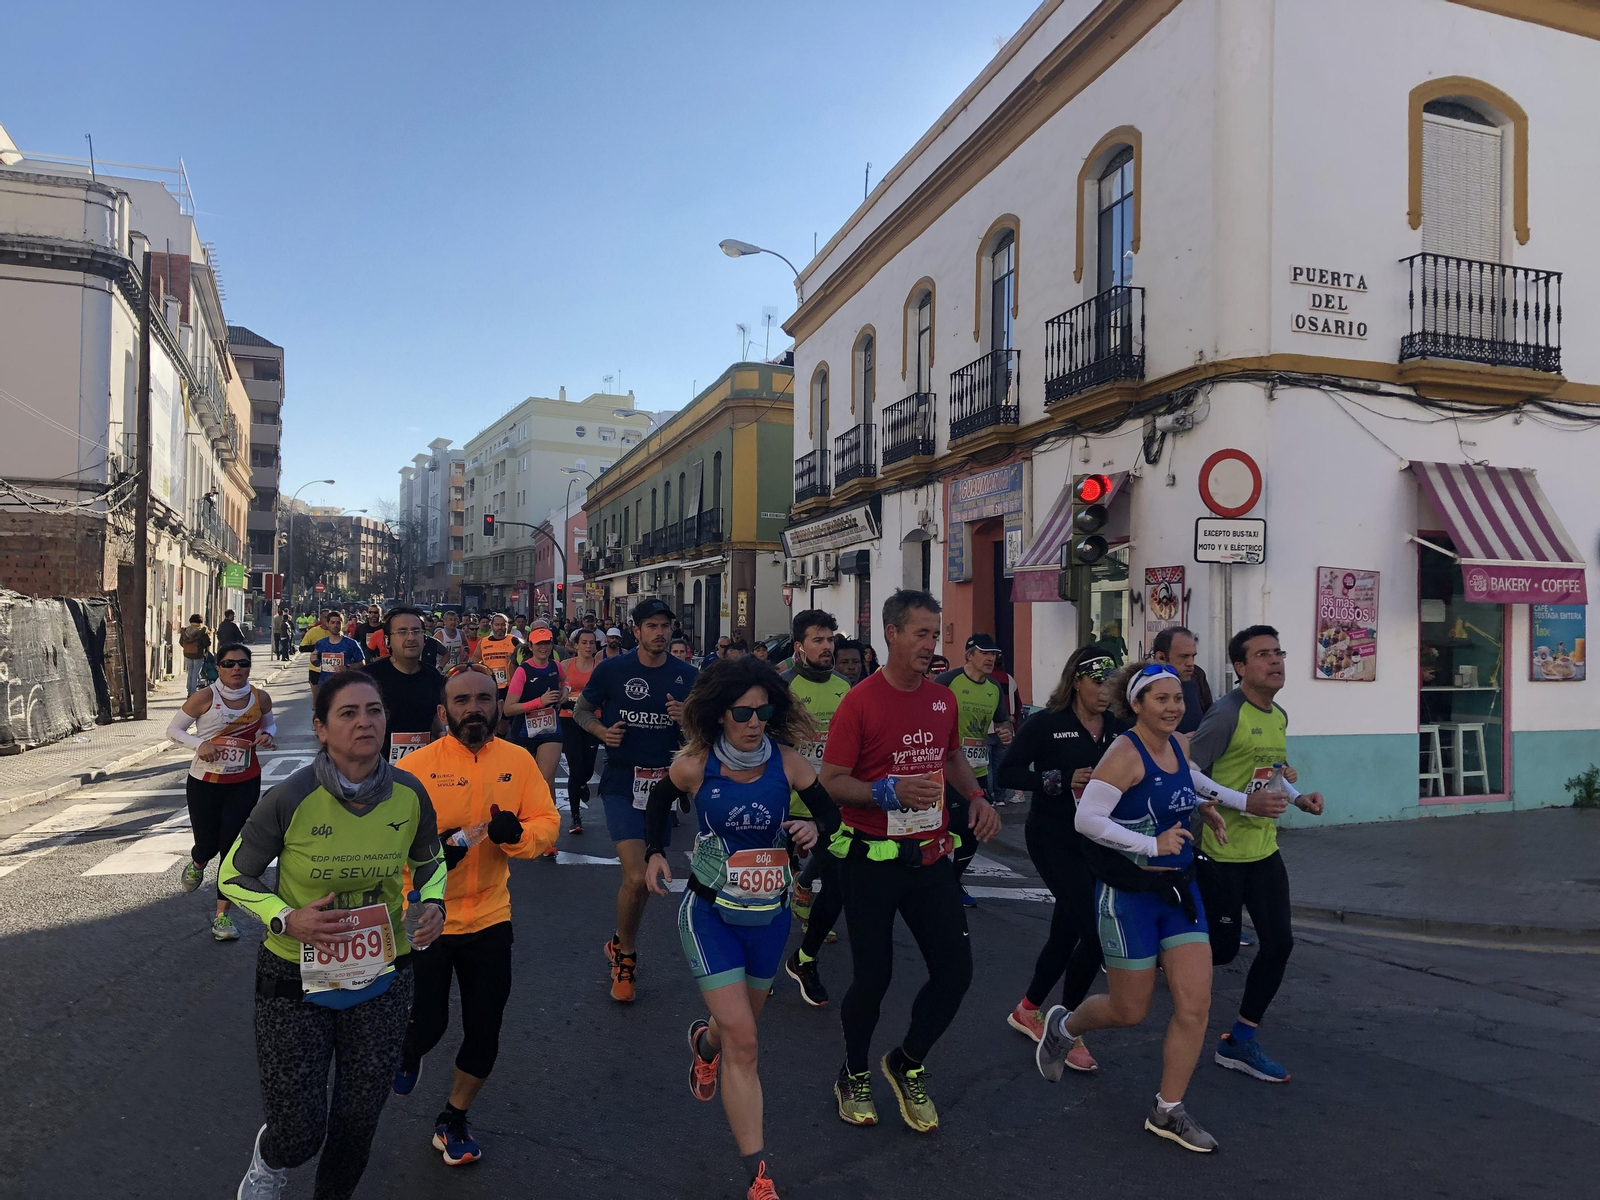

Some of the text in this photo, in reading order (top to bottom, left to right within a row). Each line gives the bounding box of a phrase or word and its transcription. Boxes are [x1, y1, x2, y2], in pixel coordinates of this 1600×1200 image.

[1292, 266, 1368, 290] PUERTA
[1311, 293, 1348, 311] DEL
[1295, 314, 1368, 337] OSARIO
[1203, 529, 1259, 538] EXCEPTO BUS-TAXI
[1198, 543, 1216, 551] MOTO
[1217, 543, 1222, 551] Y
[1230, 542, 1263, 552] ELÉCTRICO
[1490, 577, 1581, 593] BAKERY COFFEE
[1321, 594, 1334, 607] los
[1320, 606, 1369, 622] GOLOSOS
[932, 699, 947, 713] edp
[531, 715, 552, 729] 8750
[619, 709, 674, 726] TORRES
[902, 728, 934, 746] edp
[1052, 731, 1079, 739] KAWTAR
[217, 748, 245, 763] 637
[904, 746, 939, 757] maratón
[912, 752, 940, 763] sevilla
[311, 823, 333, 839] edp
[332, 854, 361, 862] MEDIO
[363, 851, 402, 861] MARATÓN
[756, 851, 772, 866] edp
[309, 865, 399, 880] DE SEVILLA
[739, 869, 785, 893] 6968
[316, 930, 382, 965] 8069
